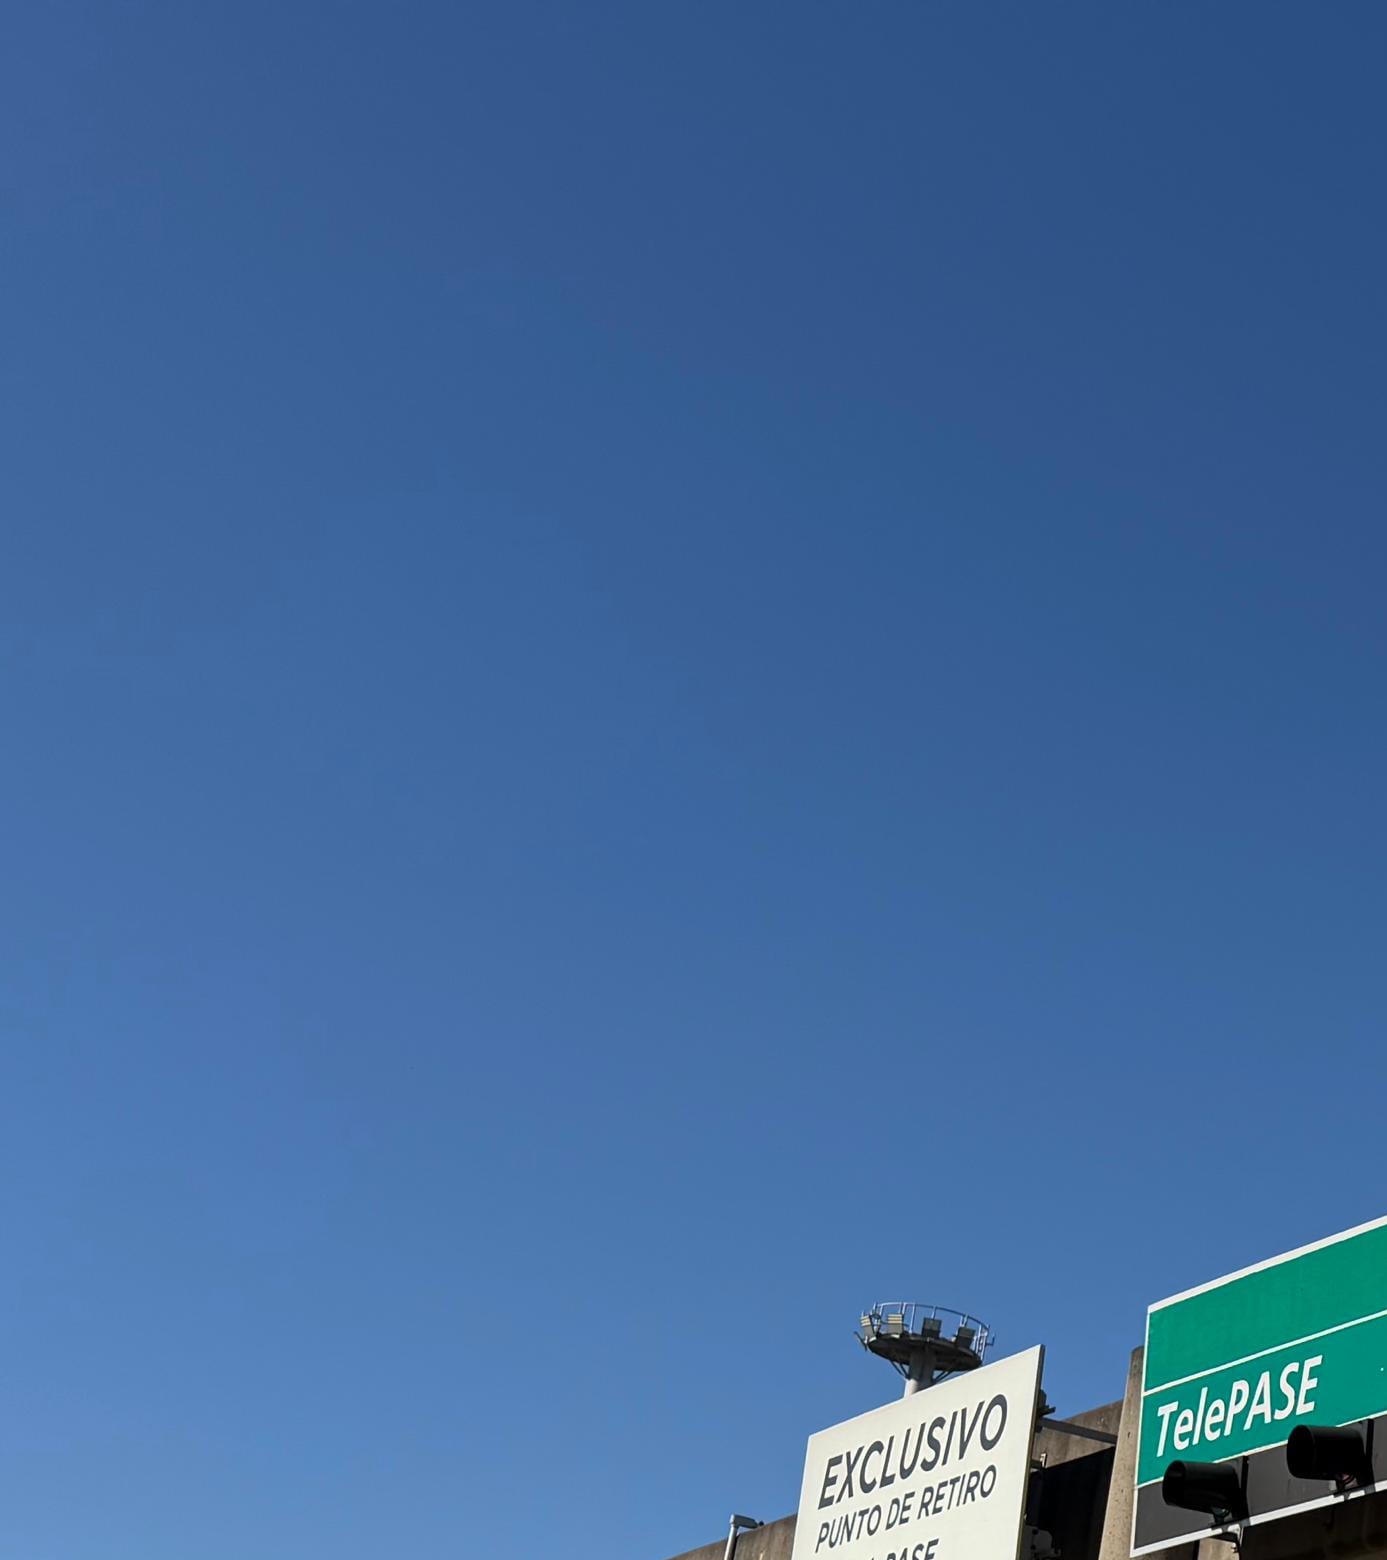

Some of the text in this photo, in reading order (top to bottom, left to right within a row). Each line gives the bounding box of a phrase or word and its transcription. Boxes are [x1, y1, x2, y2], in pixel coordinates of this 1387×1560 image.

[817, 1393, 1008, 1510] EXCLUSIVO
[1156, 1354, 1323, 1458] TelePASE
[814, 1464, 998, 1554] PUNTO DE RETIRO
